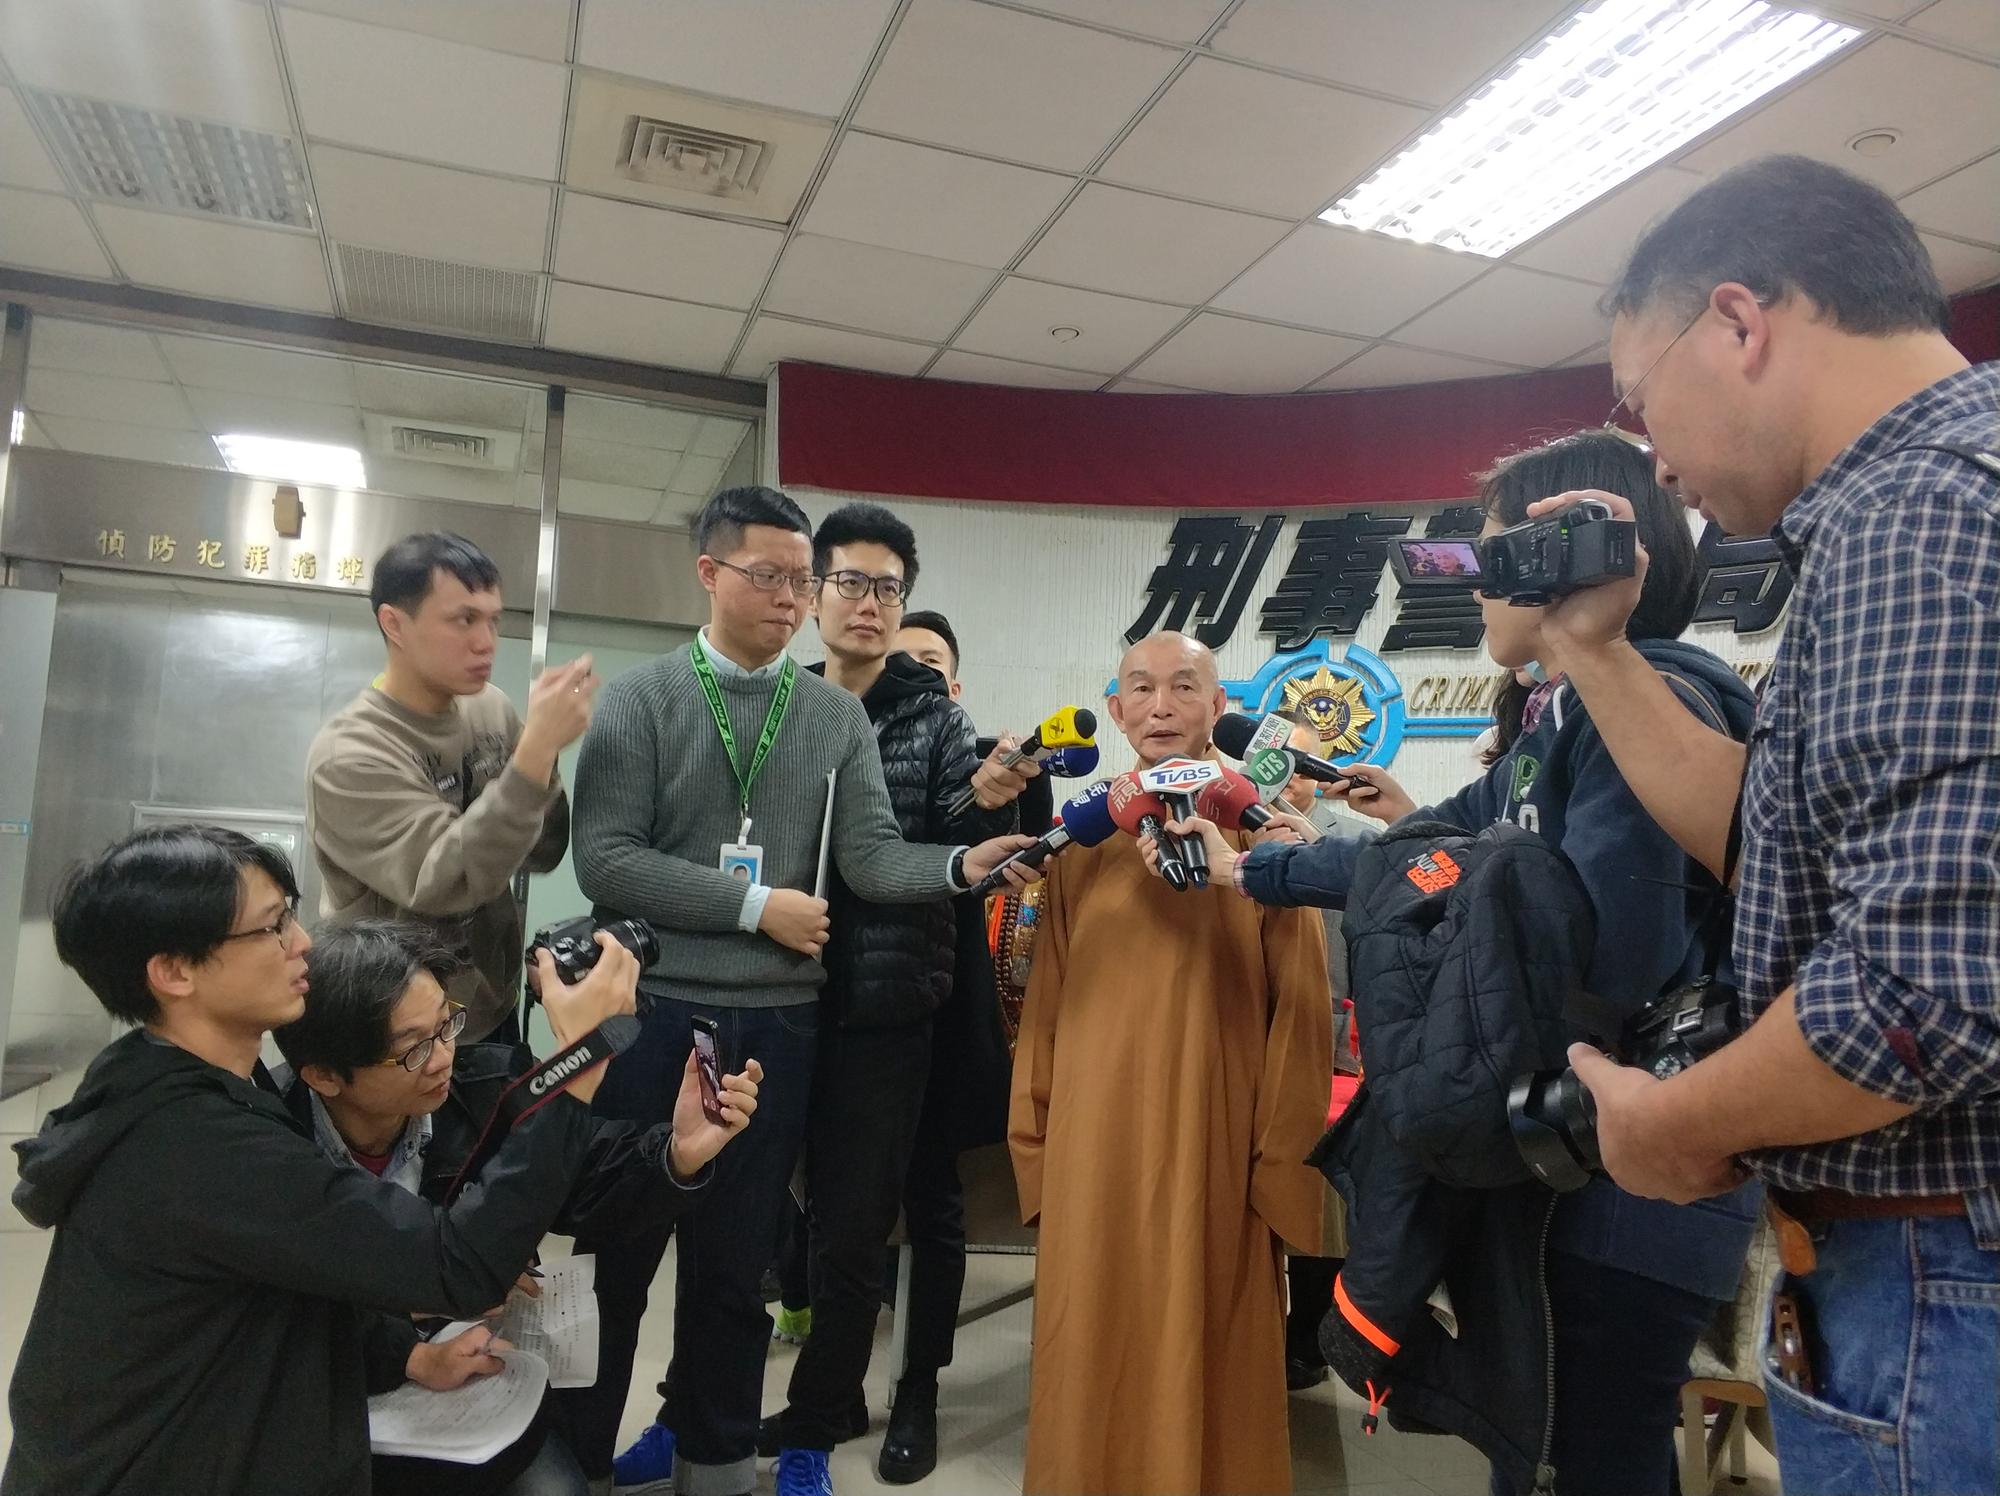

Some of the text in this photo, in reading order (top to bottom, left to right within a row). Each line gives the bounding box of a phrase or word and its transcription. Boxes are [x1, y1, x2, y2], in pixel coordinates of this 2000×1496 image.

[99, 528, 364, 586] 偵防犯罪指揮
[1409, 674, 1502, 711] CRIMI
[1149, 766, 1212, 785] TVBS
[1255, 752, 1286, 782] CTS
[529, 1045, 592, 1096] Canon
